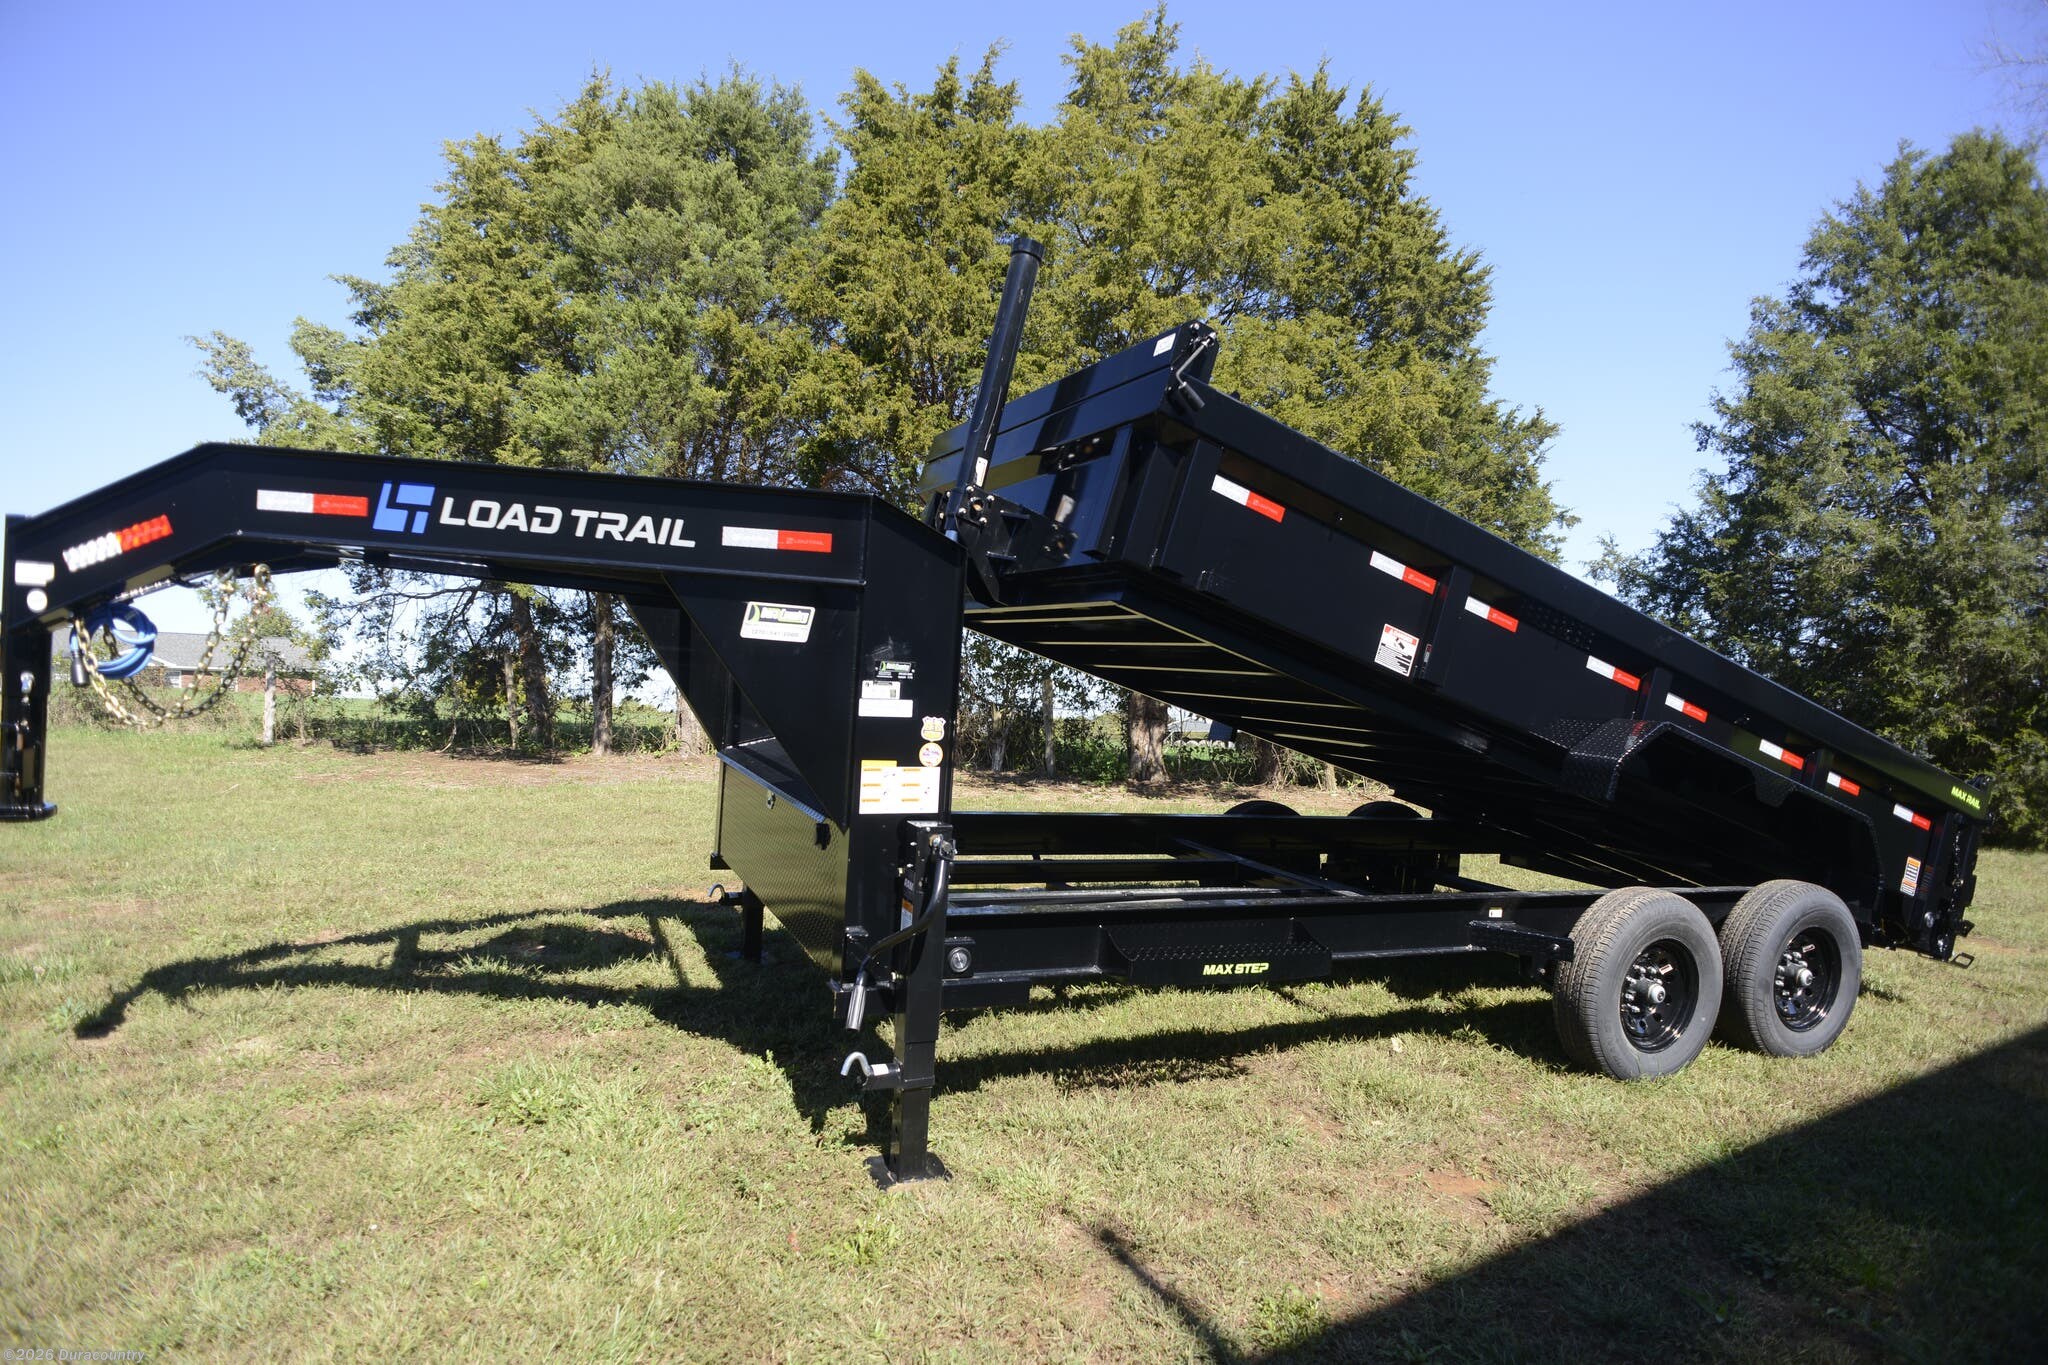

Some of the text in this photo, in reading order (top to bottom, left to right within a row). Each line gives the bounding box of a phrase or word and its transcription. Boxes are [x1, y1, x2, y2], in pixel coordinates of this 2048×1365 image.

[439, 496, 696, 548] LOAD TRAIL
[1951, 786, 1967, 801] MAX
[1203, 962, 1270, 975] MAX STEP
